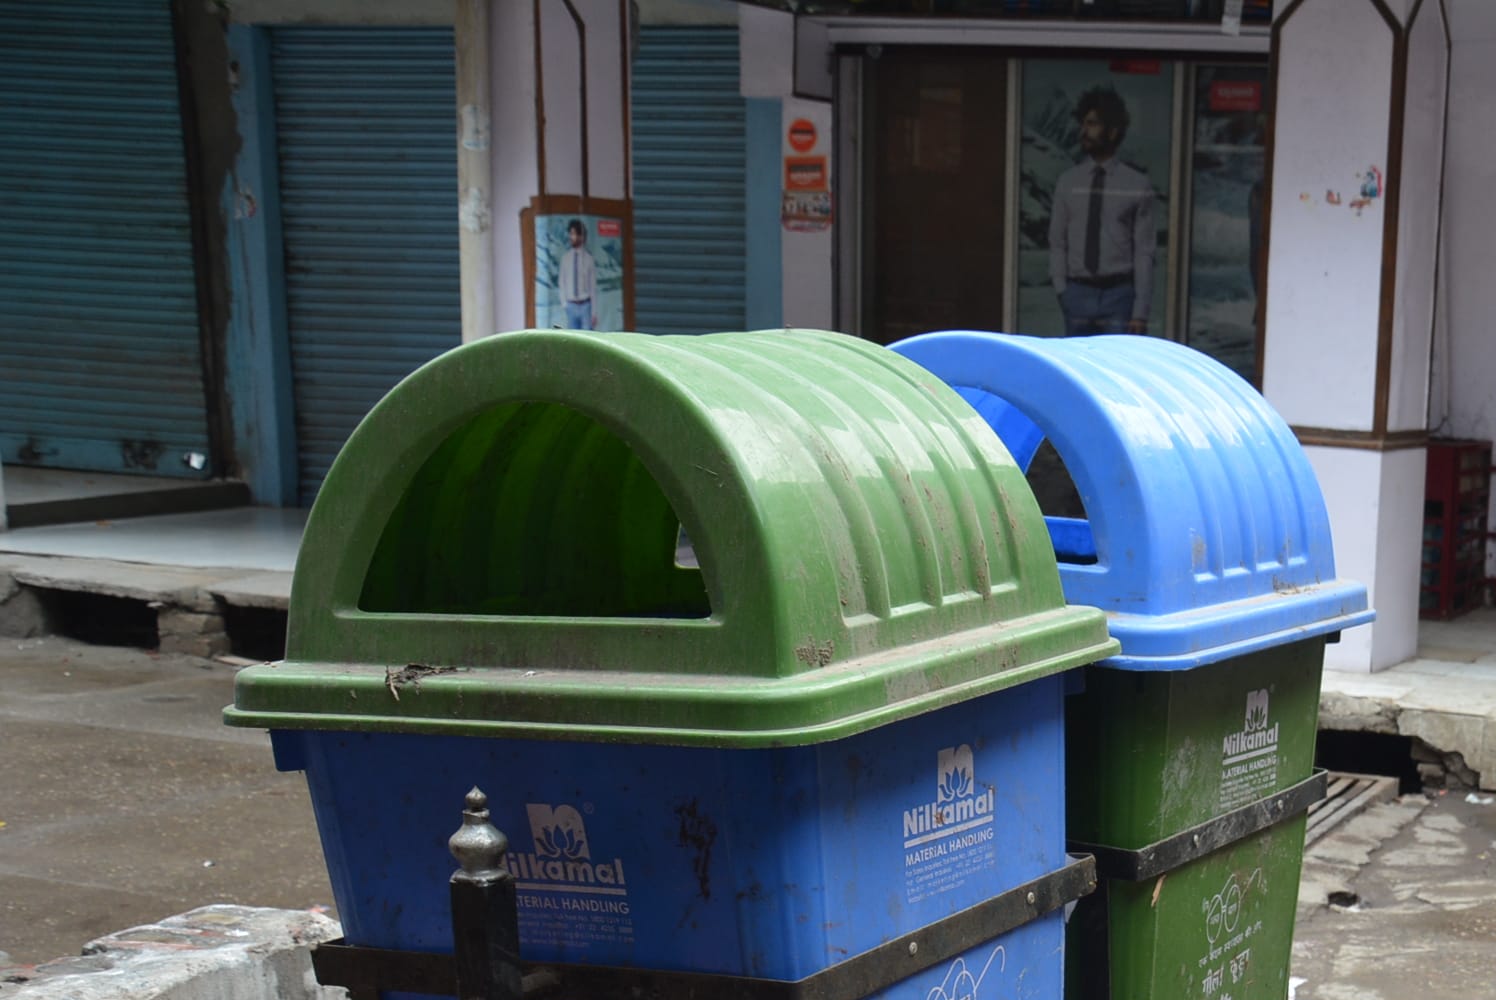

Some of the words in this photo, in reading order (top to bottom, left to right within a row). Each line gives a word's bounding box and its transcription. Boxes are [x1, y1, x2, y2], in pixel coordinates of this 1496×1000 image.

[1222, 722, 1279, 756] Nilkamal
[904, 785, 994, 837] Nilkamal
[905, 844, 948, 867] MATERIAL
[949, 827, 994, 853] HANDLING
[516, 895, 559, 909] TERIAL
[562, 899, 630, 914] HANDLING
